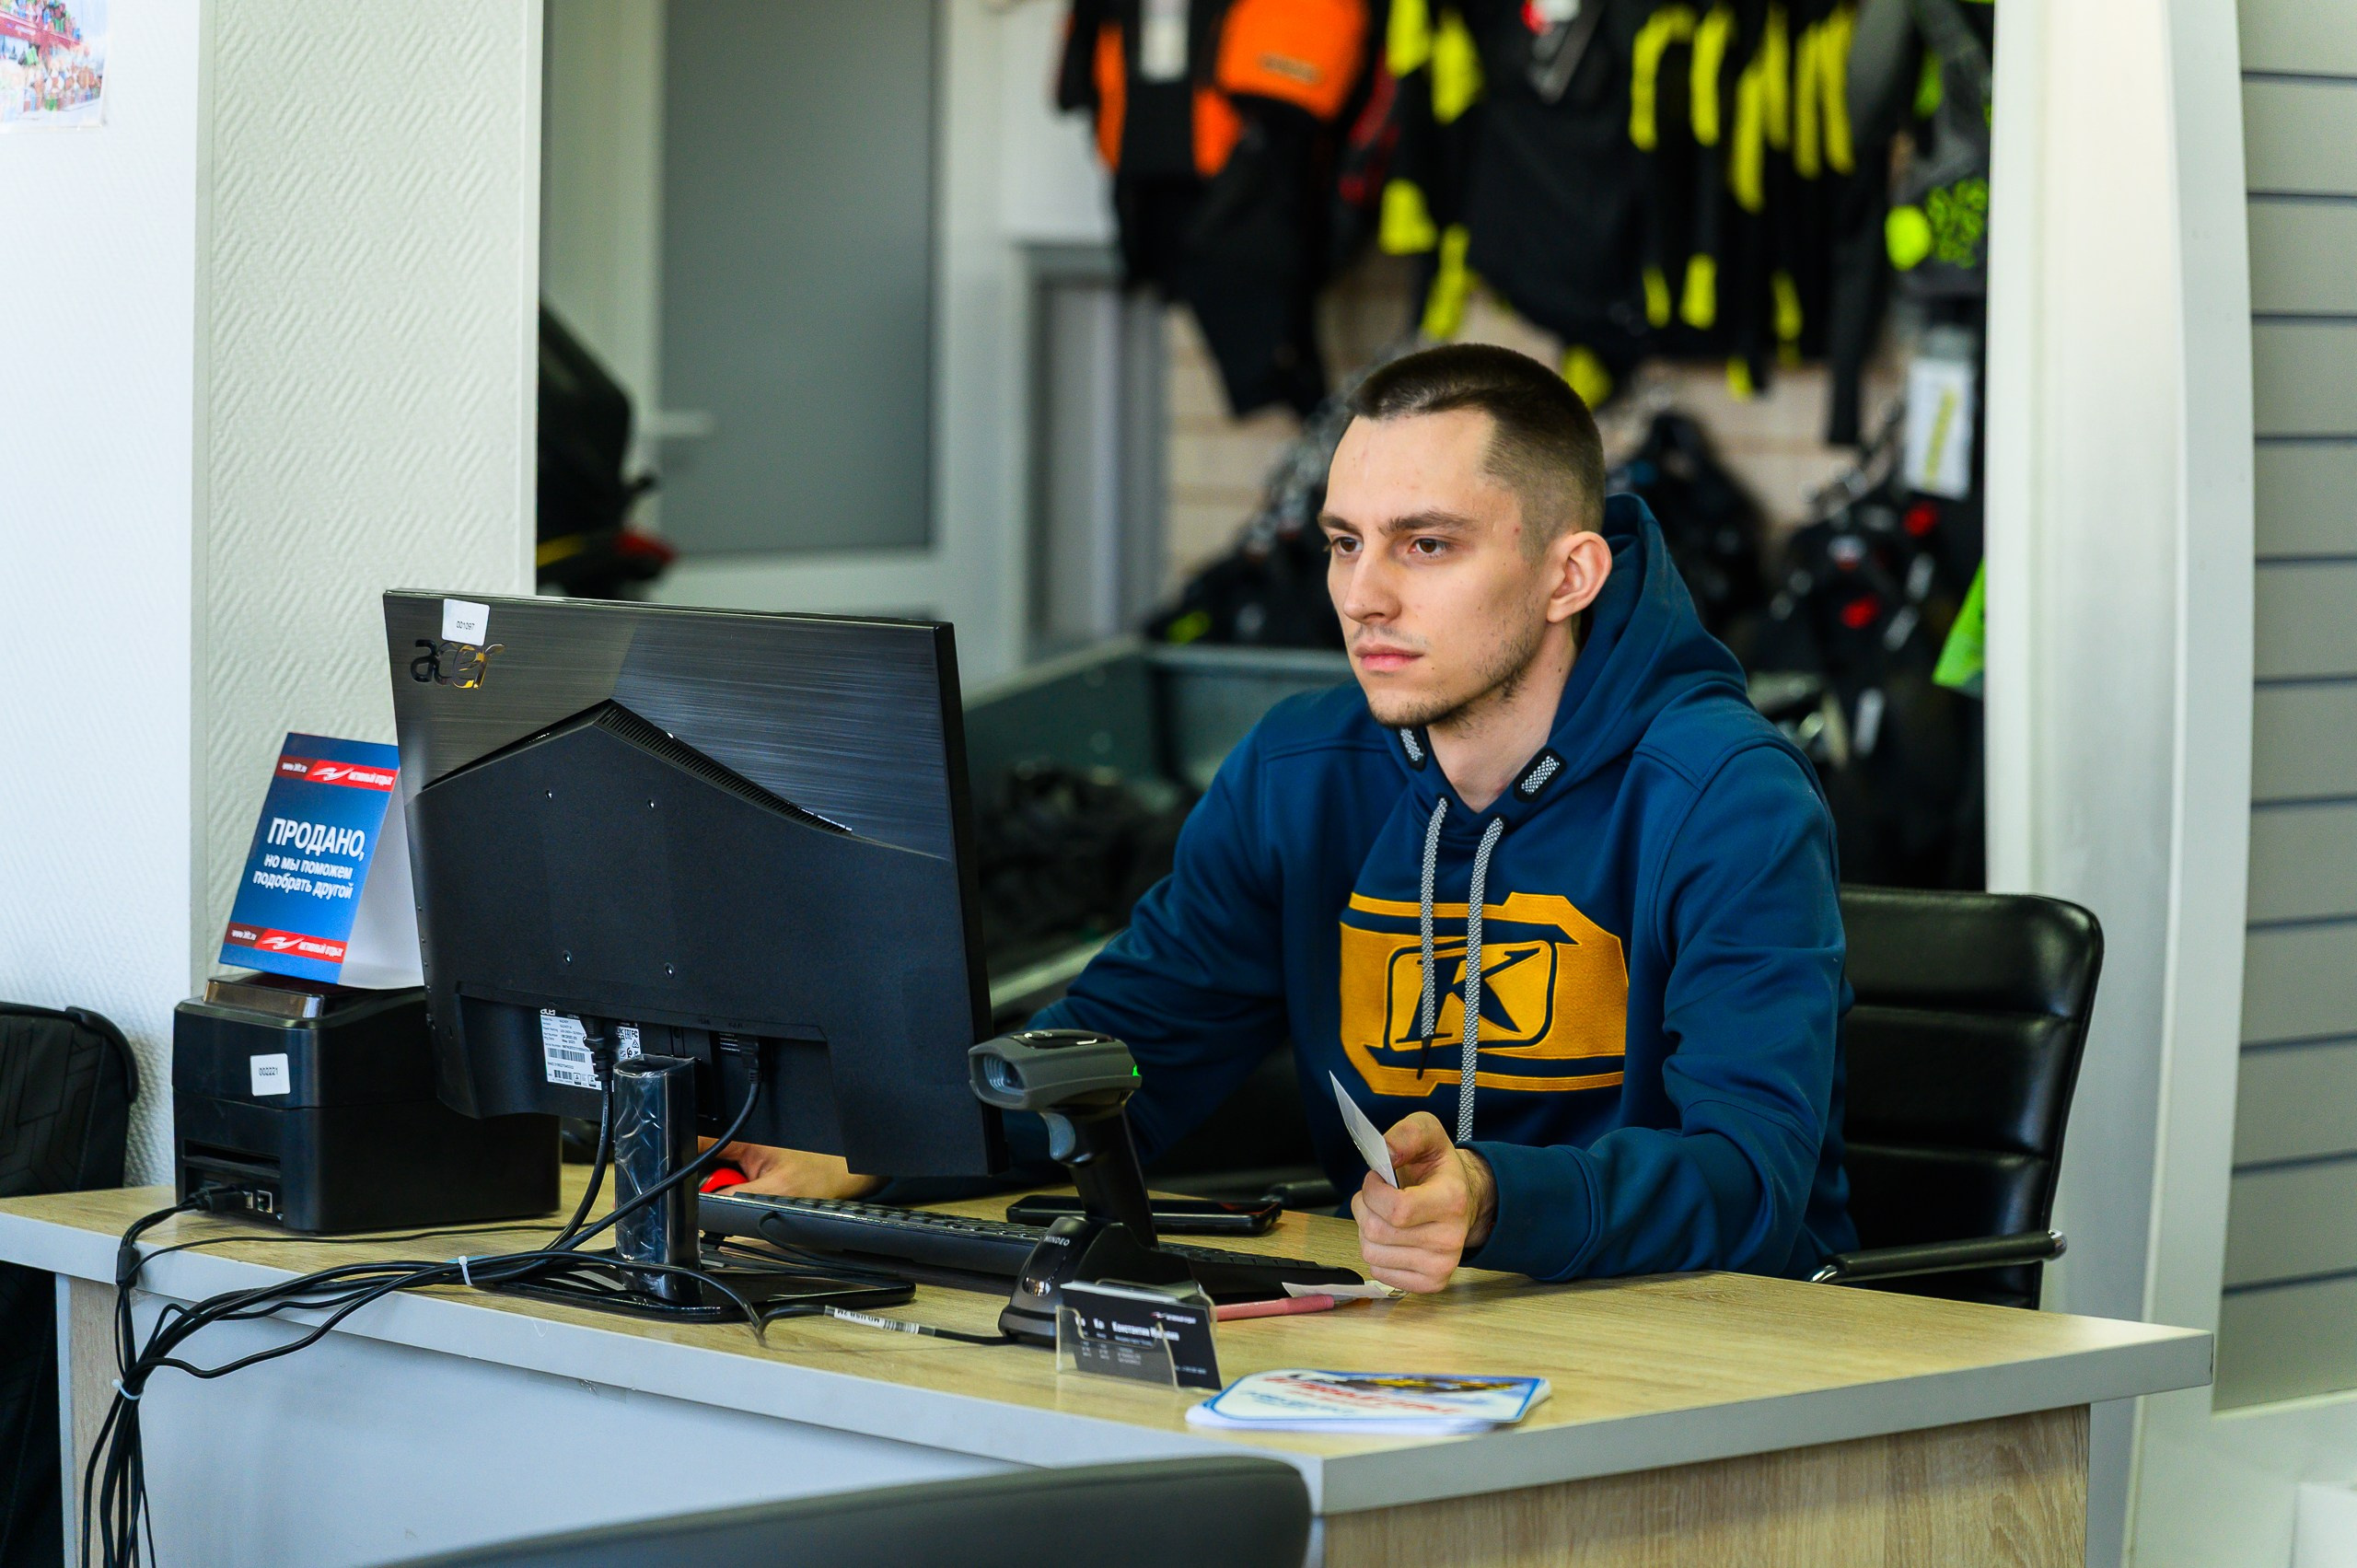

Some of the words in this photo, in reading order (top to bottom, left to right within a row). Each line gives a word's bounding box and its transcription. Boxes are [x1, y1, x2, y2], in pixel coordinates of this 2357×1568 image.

[411, 638, 505, 690] acer
[267, 817, 366, 862] ПРОДАНО,
[264, 854, 280, 868] но
[280, 855, 301, 872] мы
[300, 859, 354, 880] поможем
[252, 870, 313, 894] подобрать
[311, 881, 354, 900] другой
[1044, 1236, 1071, 1247] MINDEO
